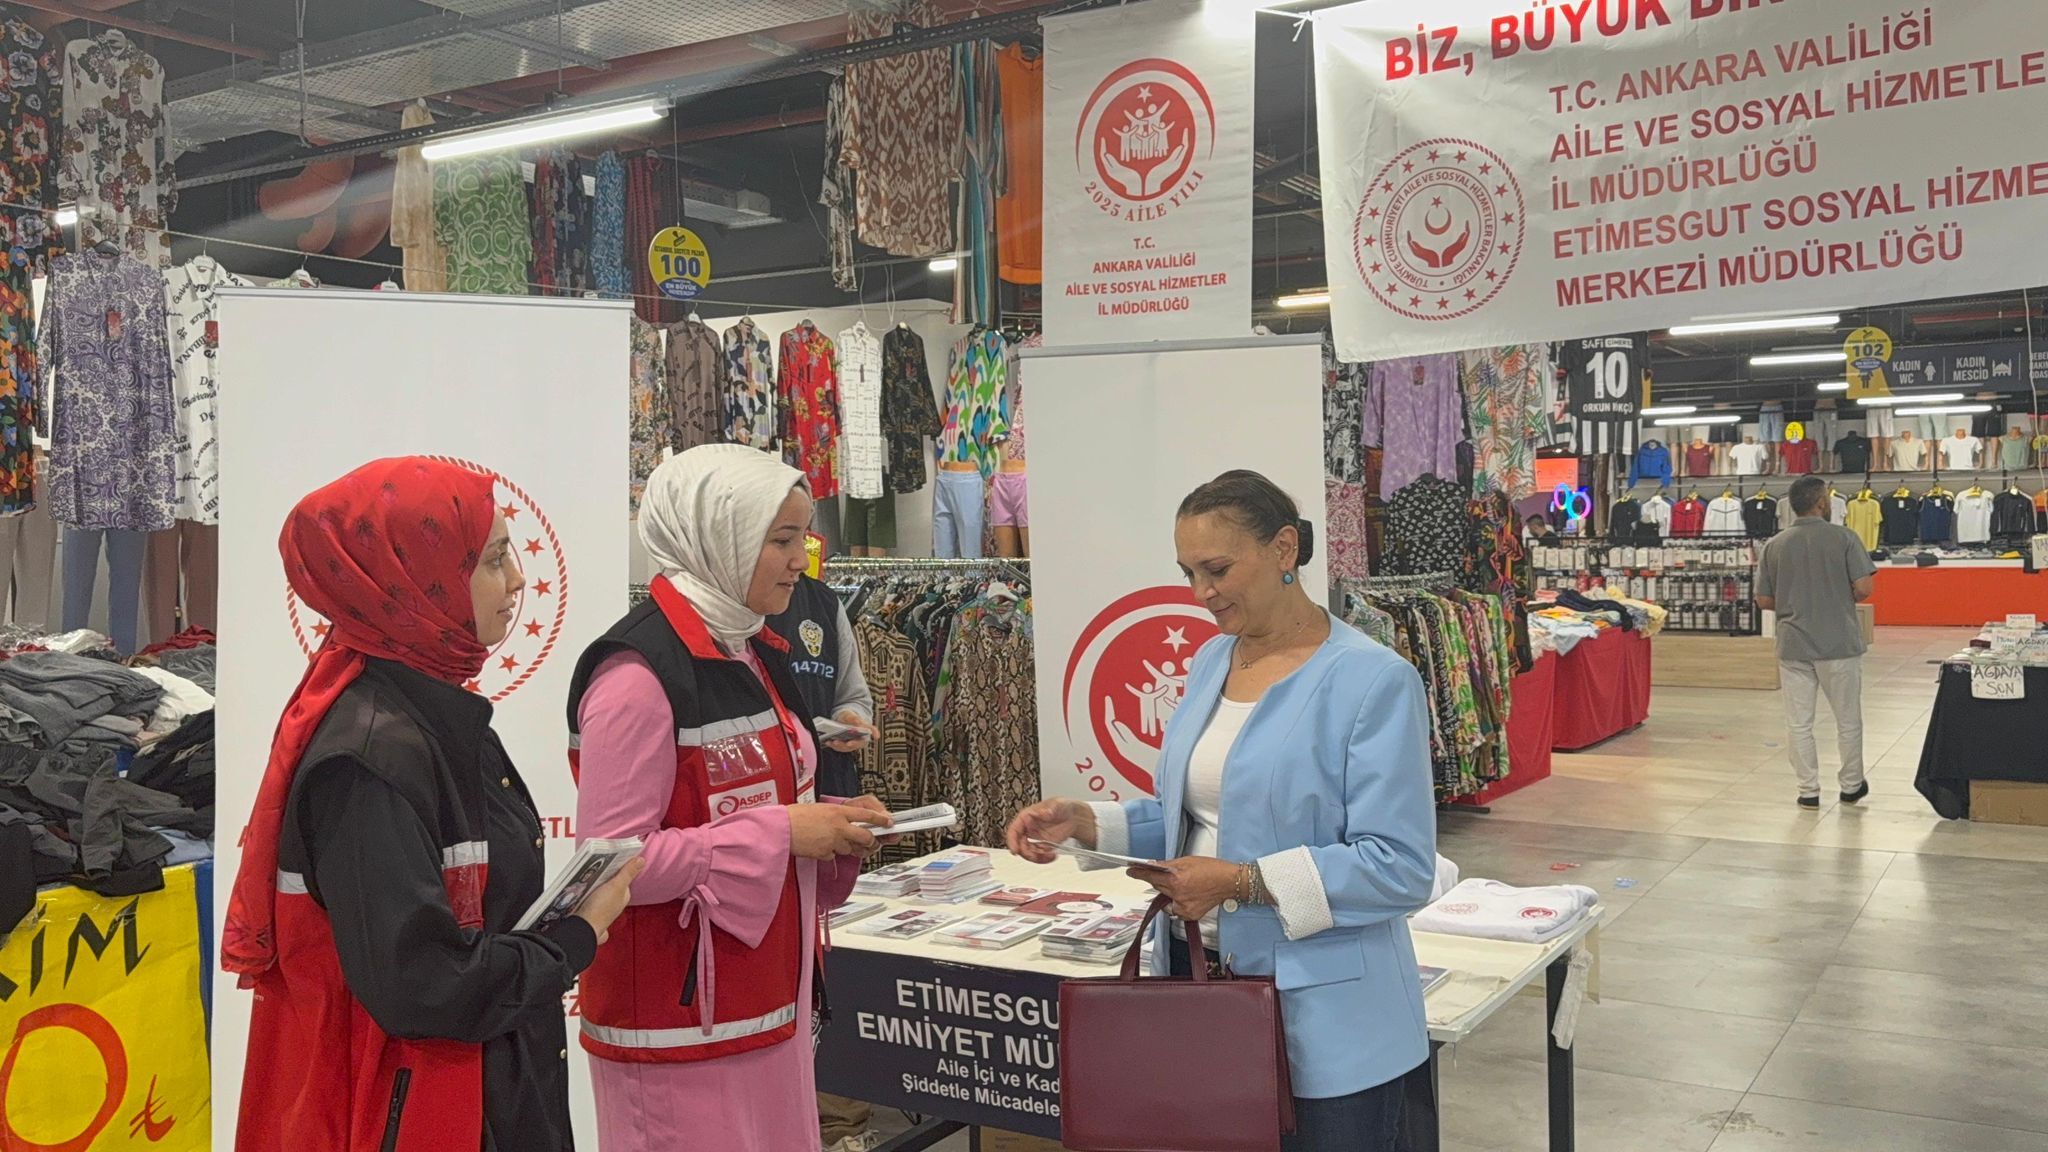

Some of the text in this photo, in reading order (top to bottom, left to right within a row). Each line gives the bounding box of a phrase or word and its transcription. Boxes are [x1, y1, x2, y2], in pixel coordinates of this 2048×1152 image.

[1385, 23, 1474, 80] BİZ,
[1549, 7, 1932, 114] T.C. ANKARA VALİLİĞİ
[1550, 123, 1624, 163] AİLE
[1634, 114, 1679, 147] VE
[1690, 89, 1835, 140] SOSYAL
[1421, 174, 1434, 183] VE
[1436, 171, 1470, 188] SOSYAL
[1552, 135, 1817, 211] İL MÜDÜRLÜĞÜ
[1084, 169, 1205, 223] 2025 AİLE YILI
[1553, 203, 1752, 259] ETİMESGUT
[1763, 183, 1916, 230] SOSYAL
[1133, 236, 1156, 250] T.C.
[661, 254, 701, 278] 100
[1092, 252, 1196, 274] ANKARA VALİLİĞİ
[1556, 222, 1963, 307] MERKEZİ MÜDÜRLÜĞÜ
[1065, 272, 1227, 296] AİLE VE SOSYAL HİZMETLER
[1098, 298, 1190, 316] İL MÜDÜRLÜĞÜ
[1852, 343, 1884, 357] 102
[1892, 360, 1921, 373] KADIN
[1953, 367, 1989, 381] MESCİD
[1956, 356, 1986, 369] KADIN
[1586, 351, 1629, 399] 10
[1899, 373, 1914, 384] WC
[1582, 402, 1611, 413] ORKUN
[1986, 682, 2015, 695] SON
[740, 791, 772, 806] ASDEP
[857, 1011, 994, 1059] EMNİYET
[936, 1058, 969, 1079] Aile
[974, 1060, 995, 1084] İçi
[999, 1071, 1021, 1087] ve
[902, 1073, 1060, 1118] Şiddetle Mücadele
